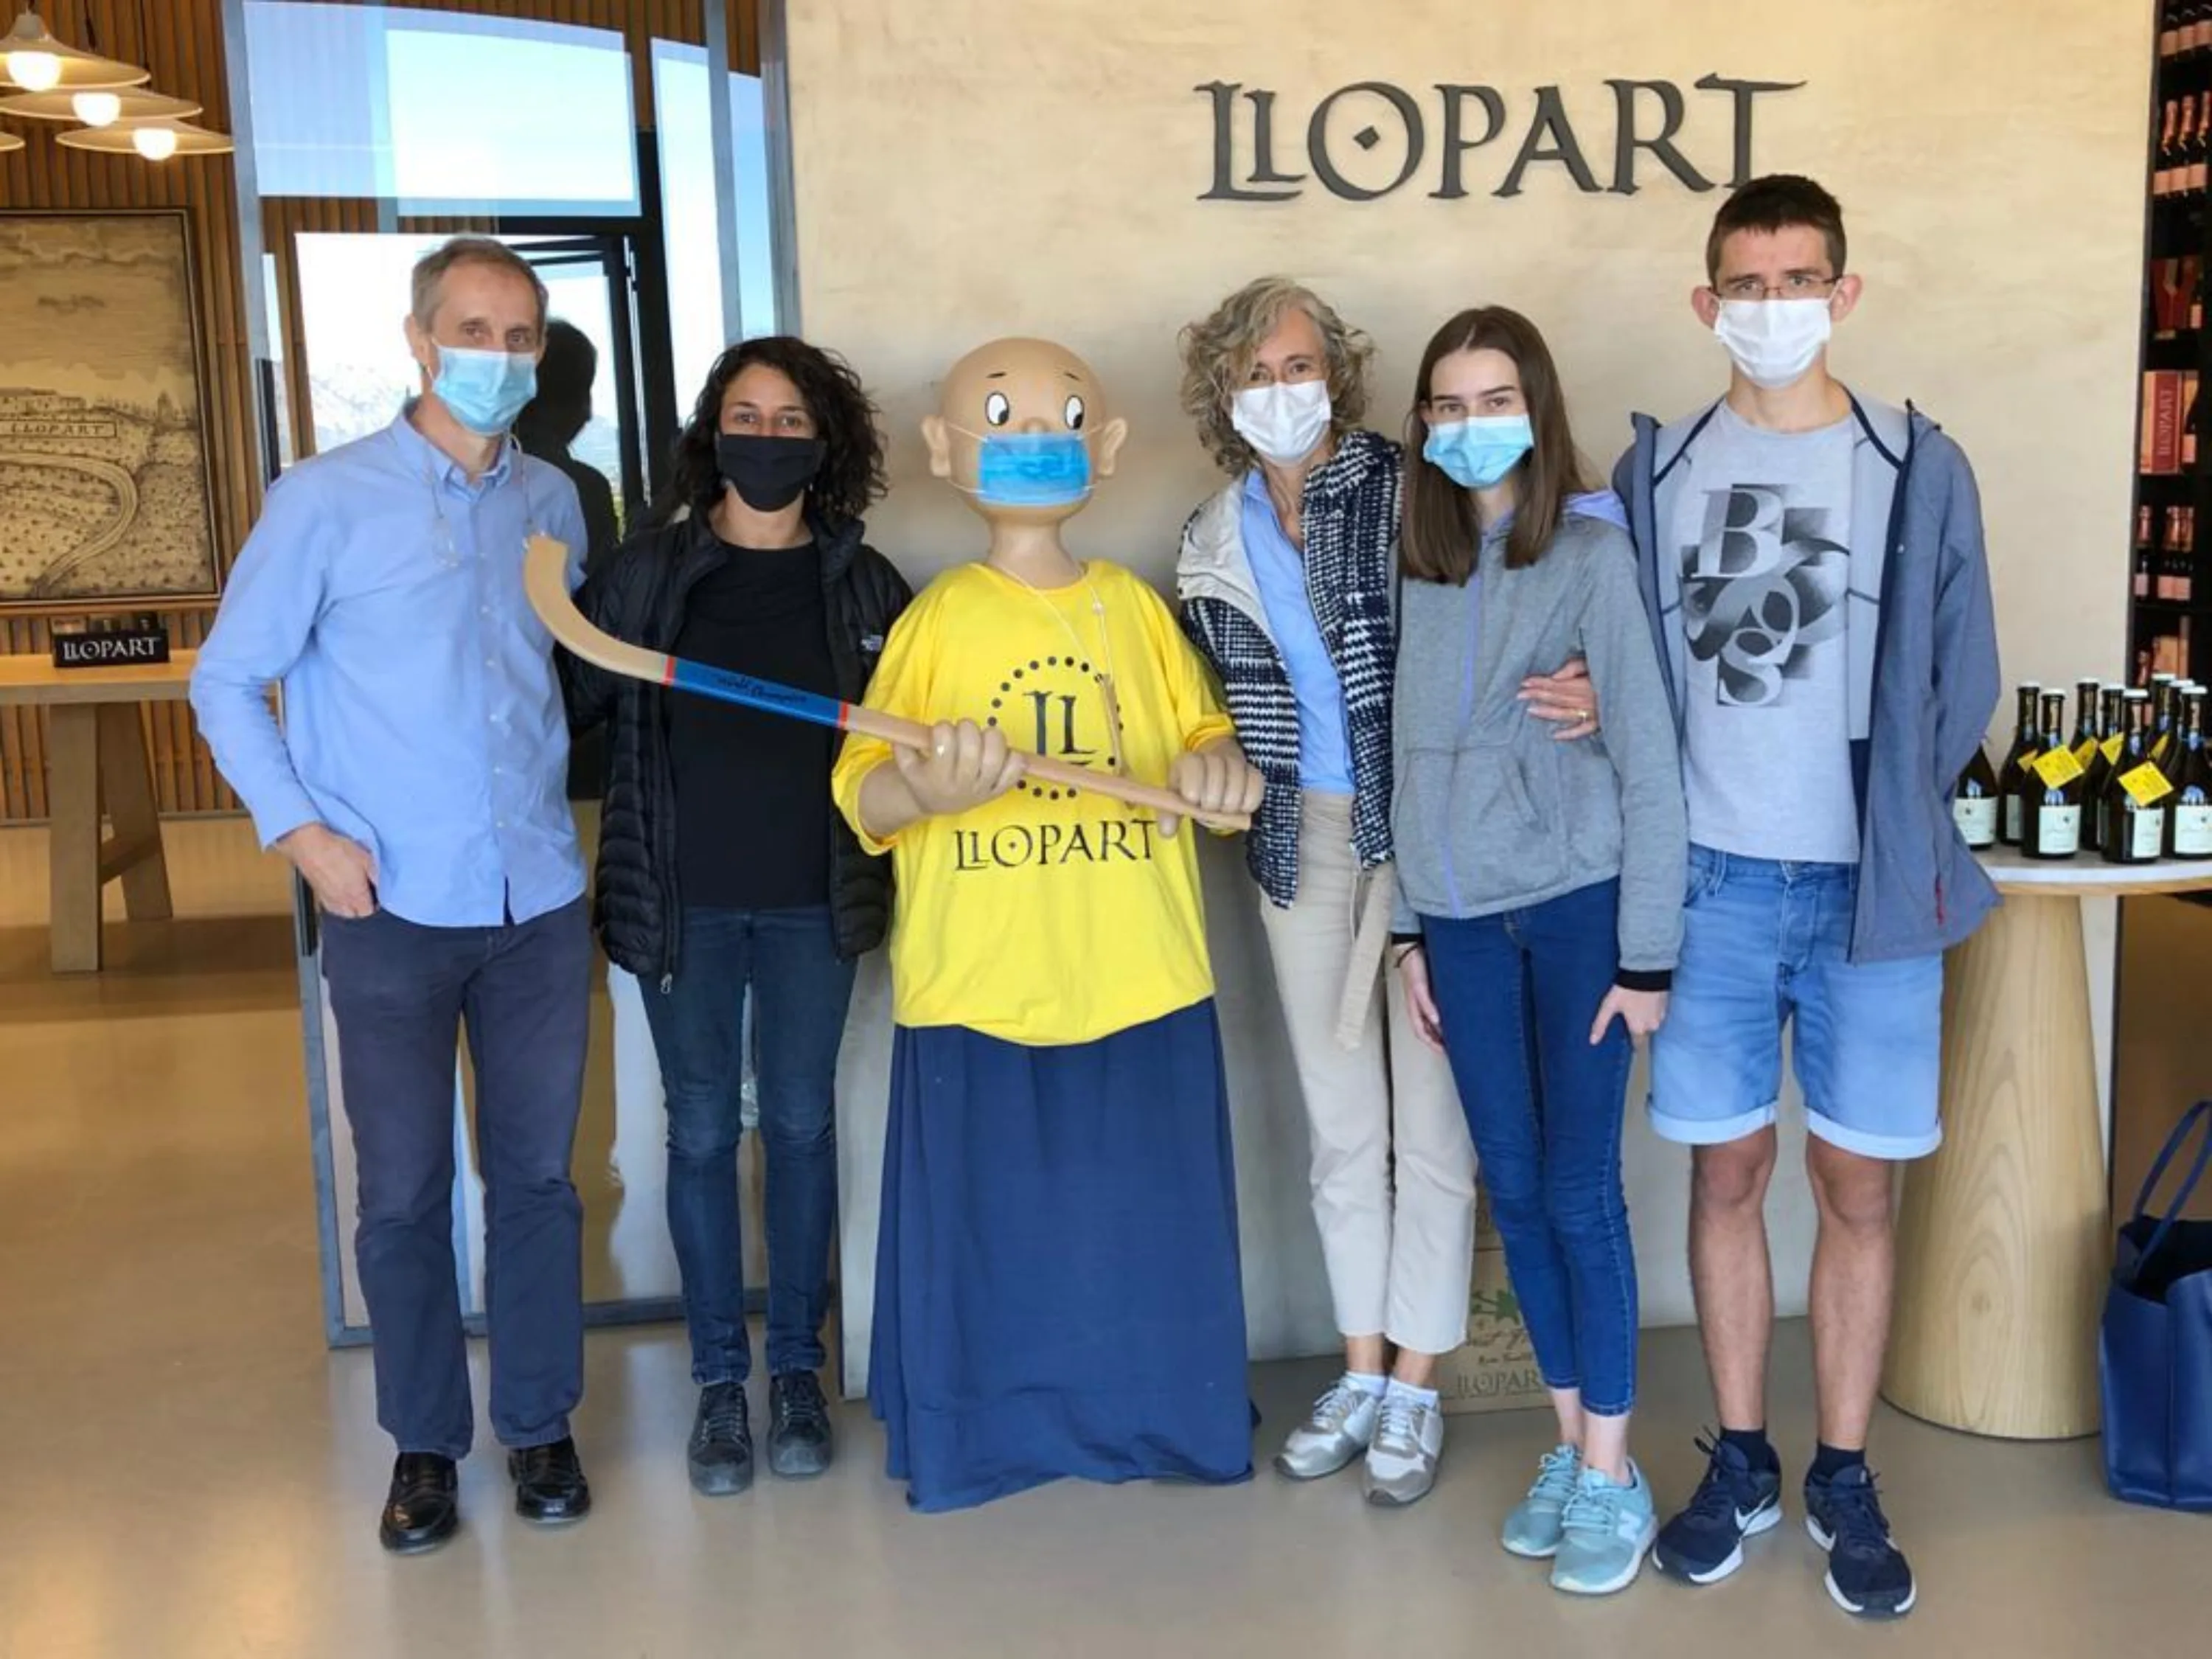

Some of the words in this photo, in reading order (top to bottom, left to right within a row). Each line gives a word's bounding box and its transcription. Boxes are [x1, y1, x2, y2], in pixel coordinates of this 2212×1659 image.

[1192, 72, 1808, 201] LLOPART
[63, 636, 162, 661] LLOPART
[953, 818, 1158, 872] LLOPART
[1457, 1368, 1543, 1399] LLOPAR
